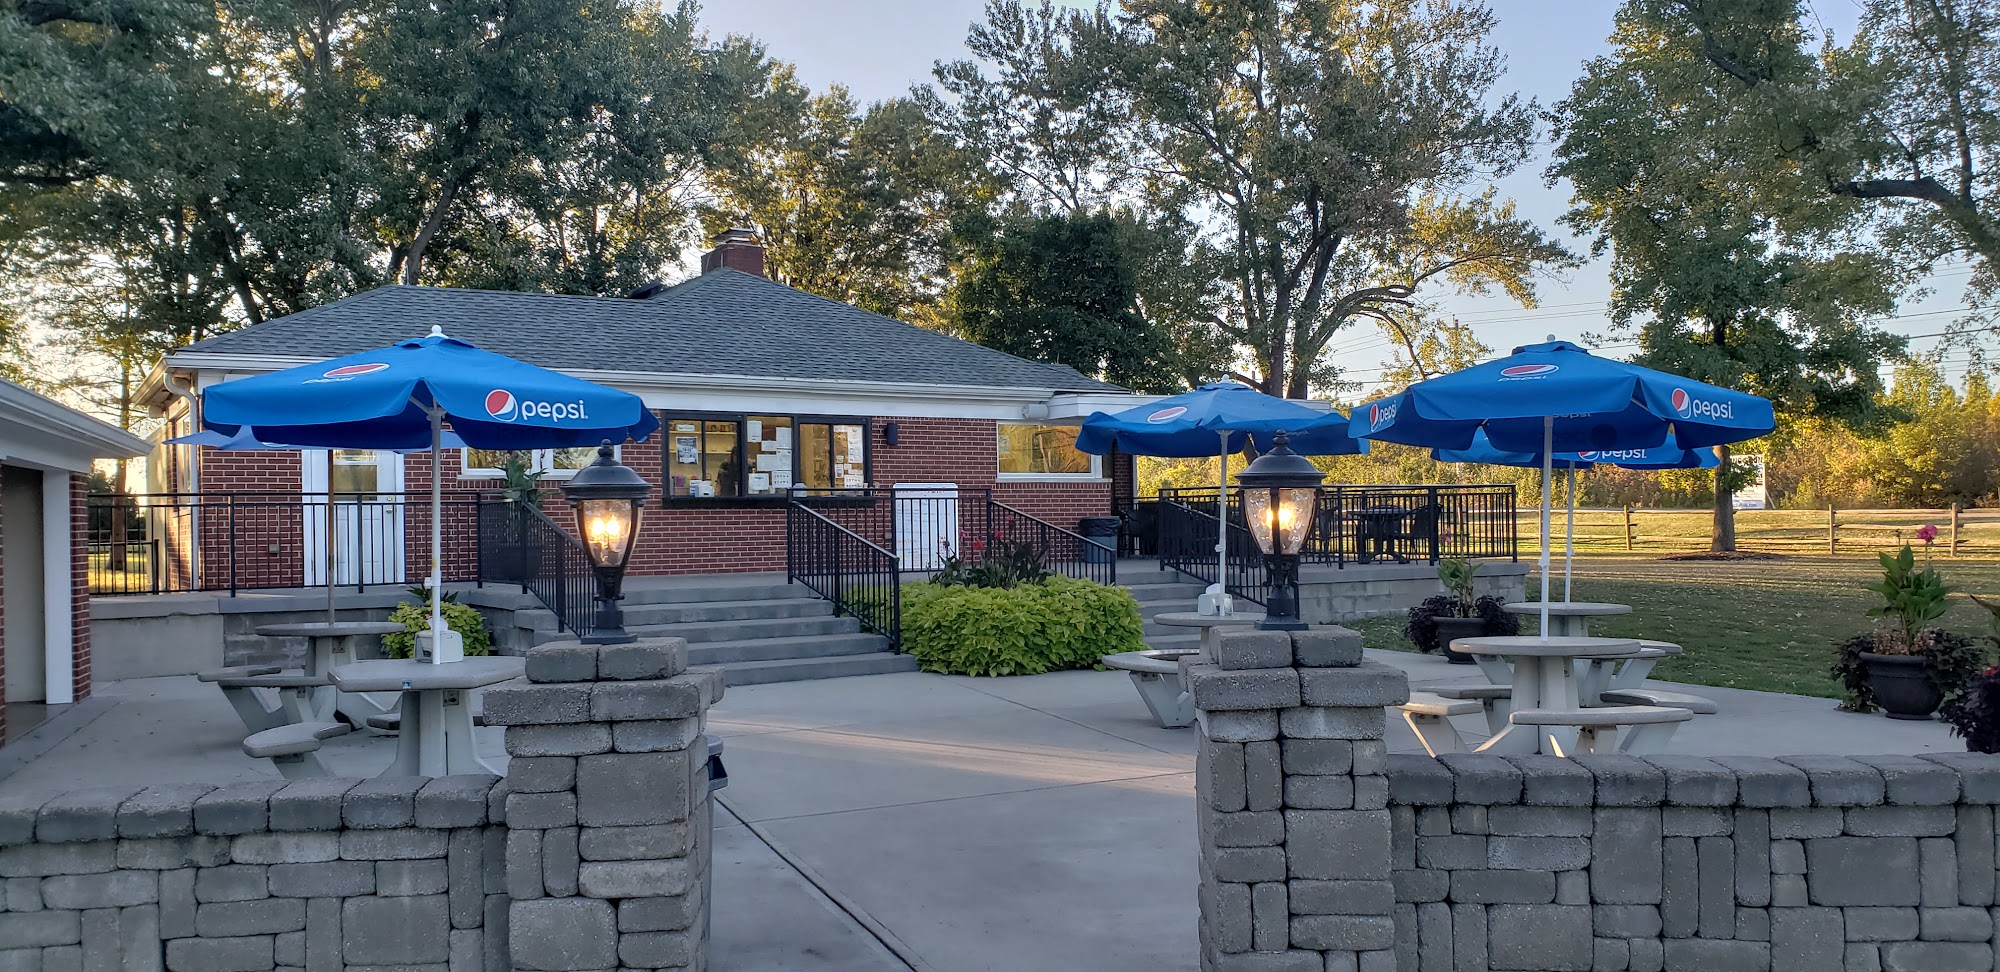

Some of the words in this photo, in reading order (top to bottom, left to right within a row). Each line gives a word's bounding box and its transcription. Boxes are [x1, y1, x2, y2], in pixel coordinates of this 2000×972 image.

[522, 400, 585, 422] pepsi
[1379, 400, 1396, 426] pepsi
[1692, 400, 1732, 420] pepsi
